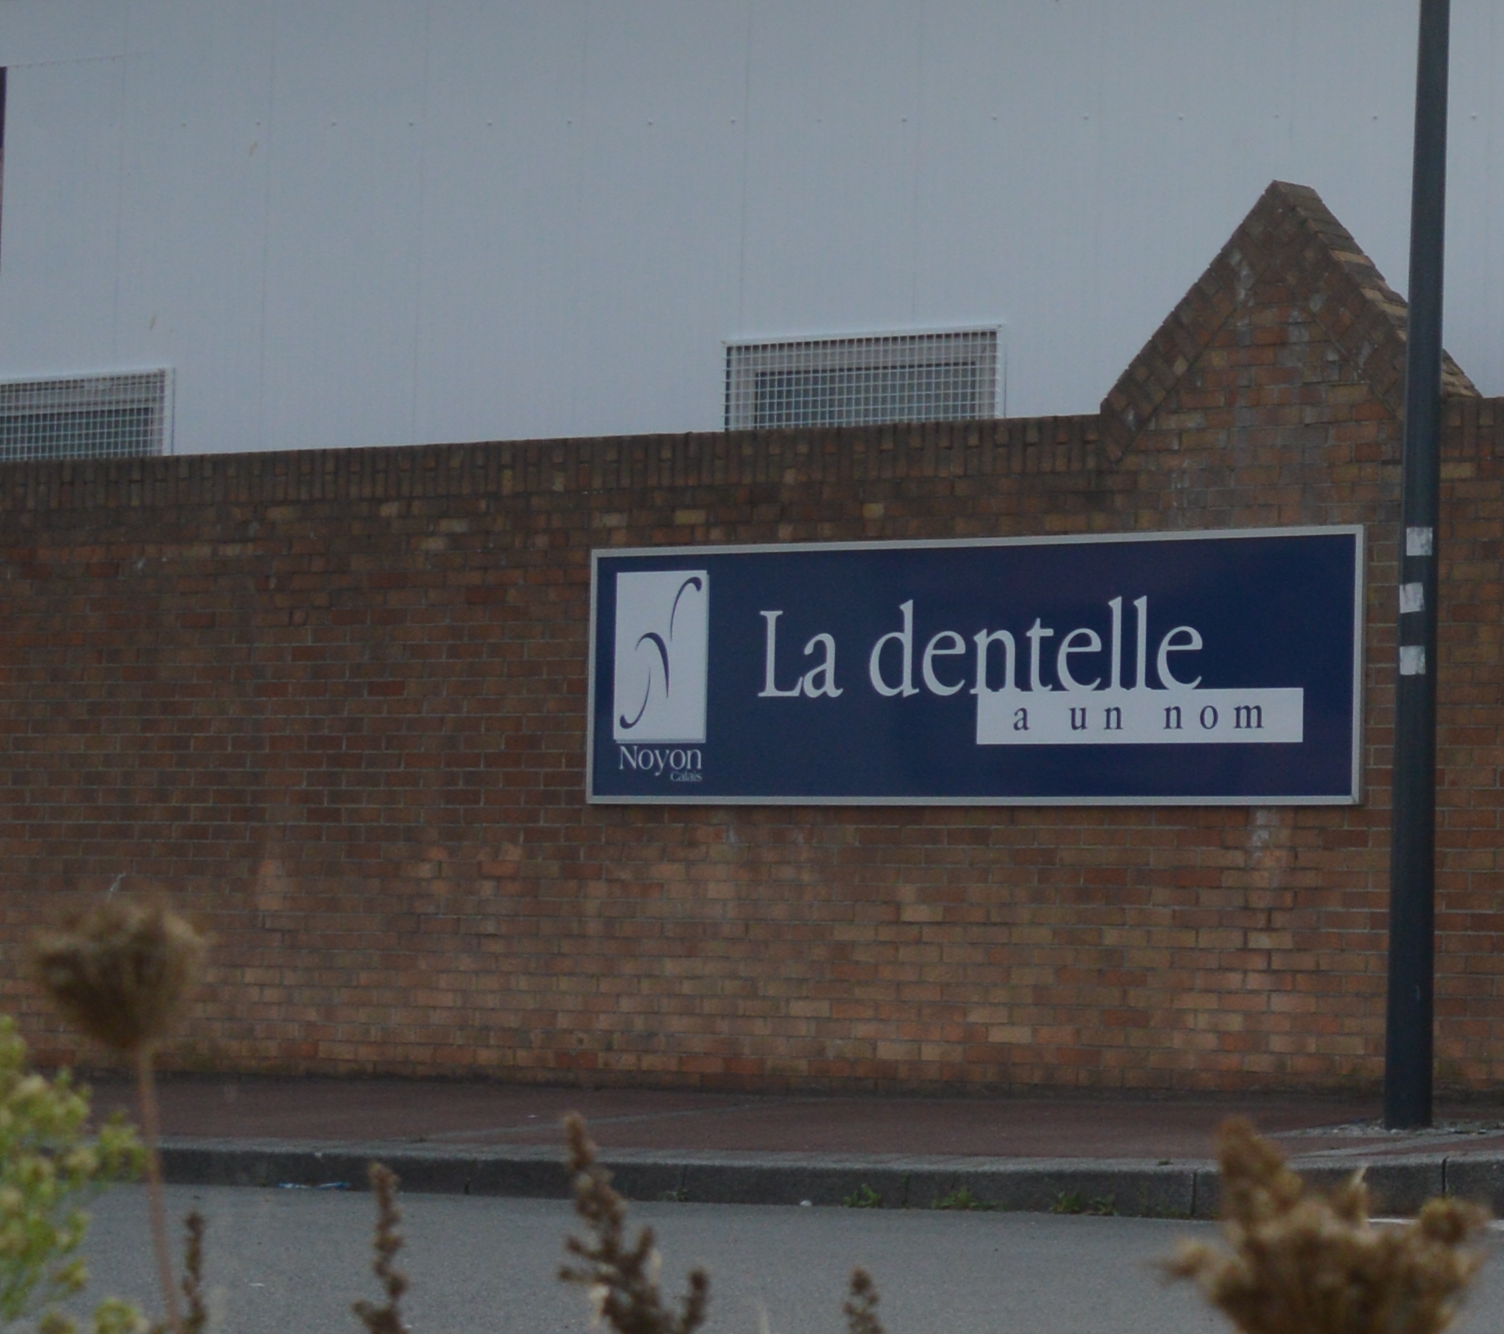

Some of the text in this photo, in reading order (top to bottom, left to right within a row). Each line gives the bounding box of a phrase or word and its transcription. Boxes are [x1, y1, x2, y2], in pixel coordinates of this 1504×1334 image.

[758, 595, 1203, 698] La dentelle
[1013, 702, 1264, 732] a un nom
[619, 745, 702, 776] Noyon
